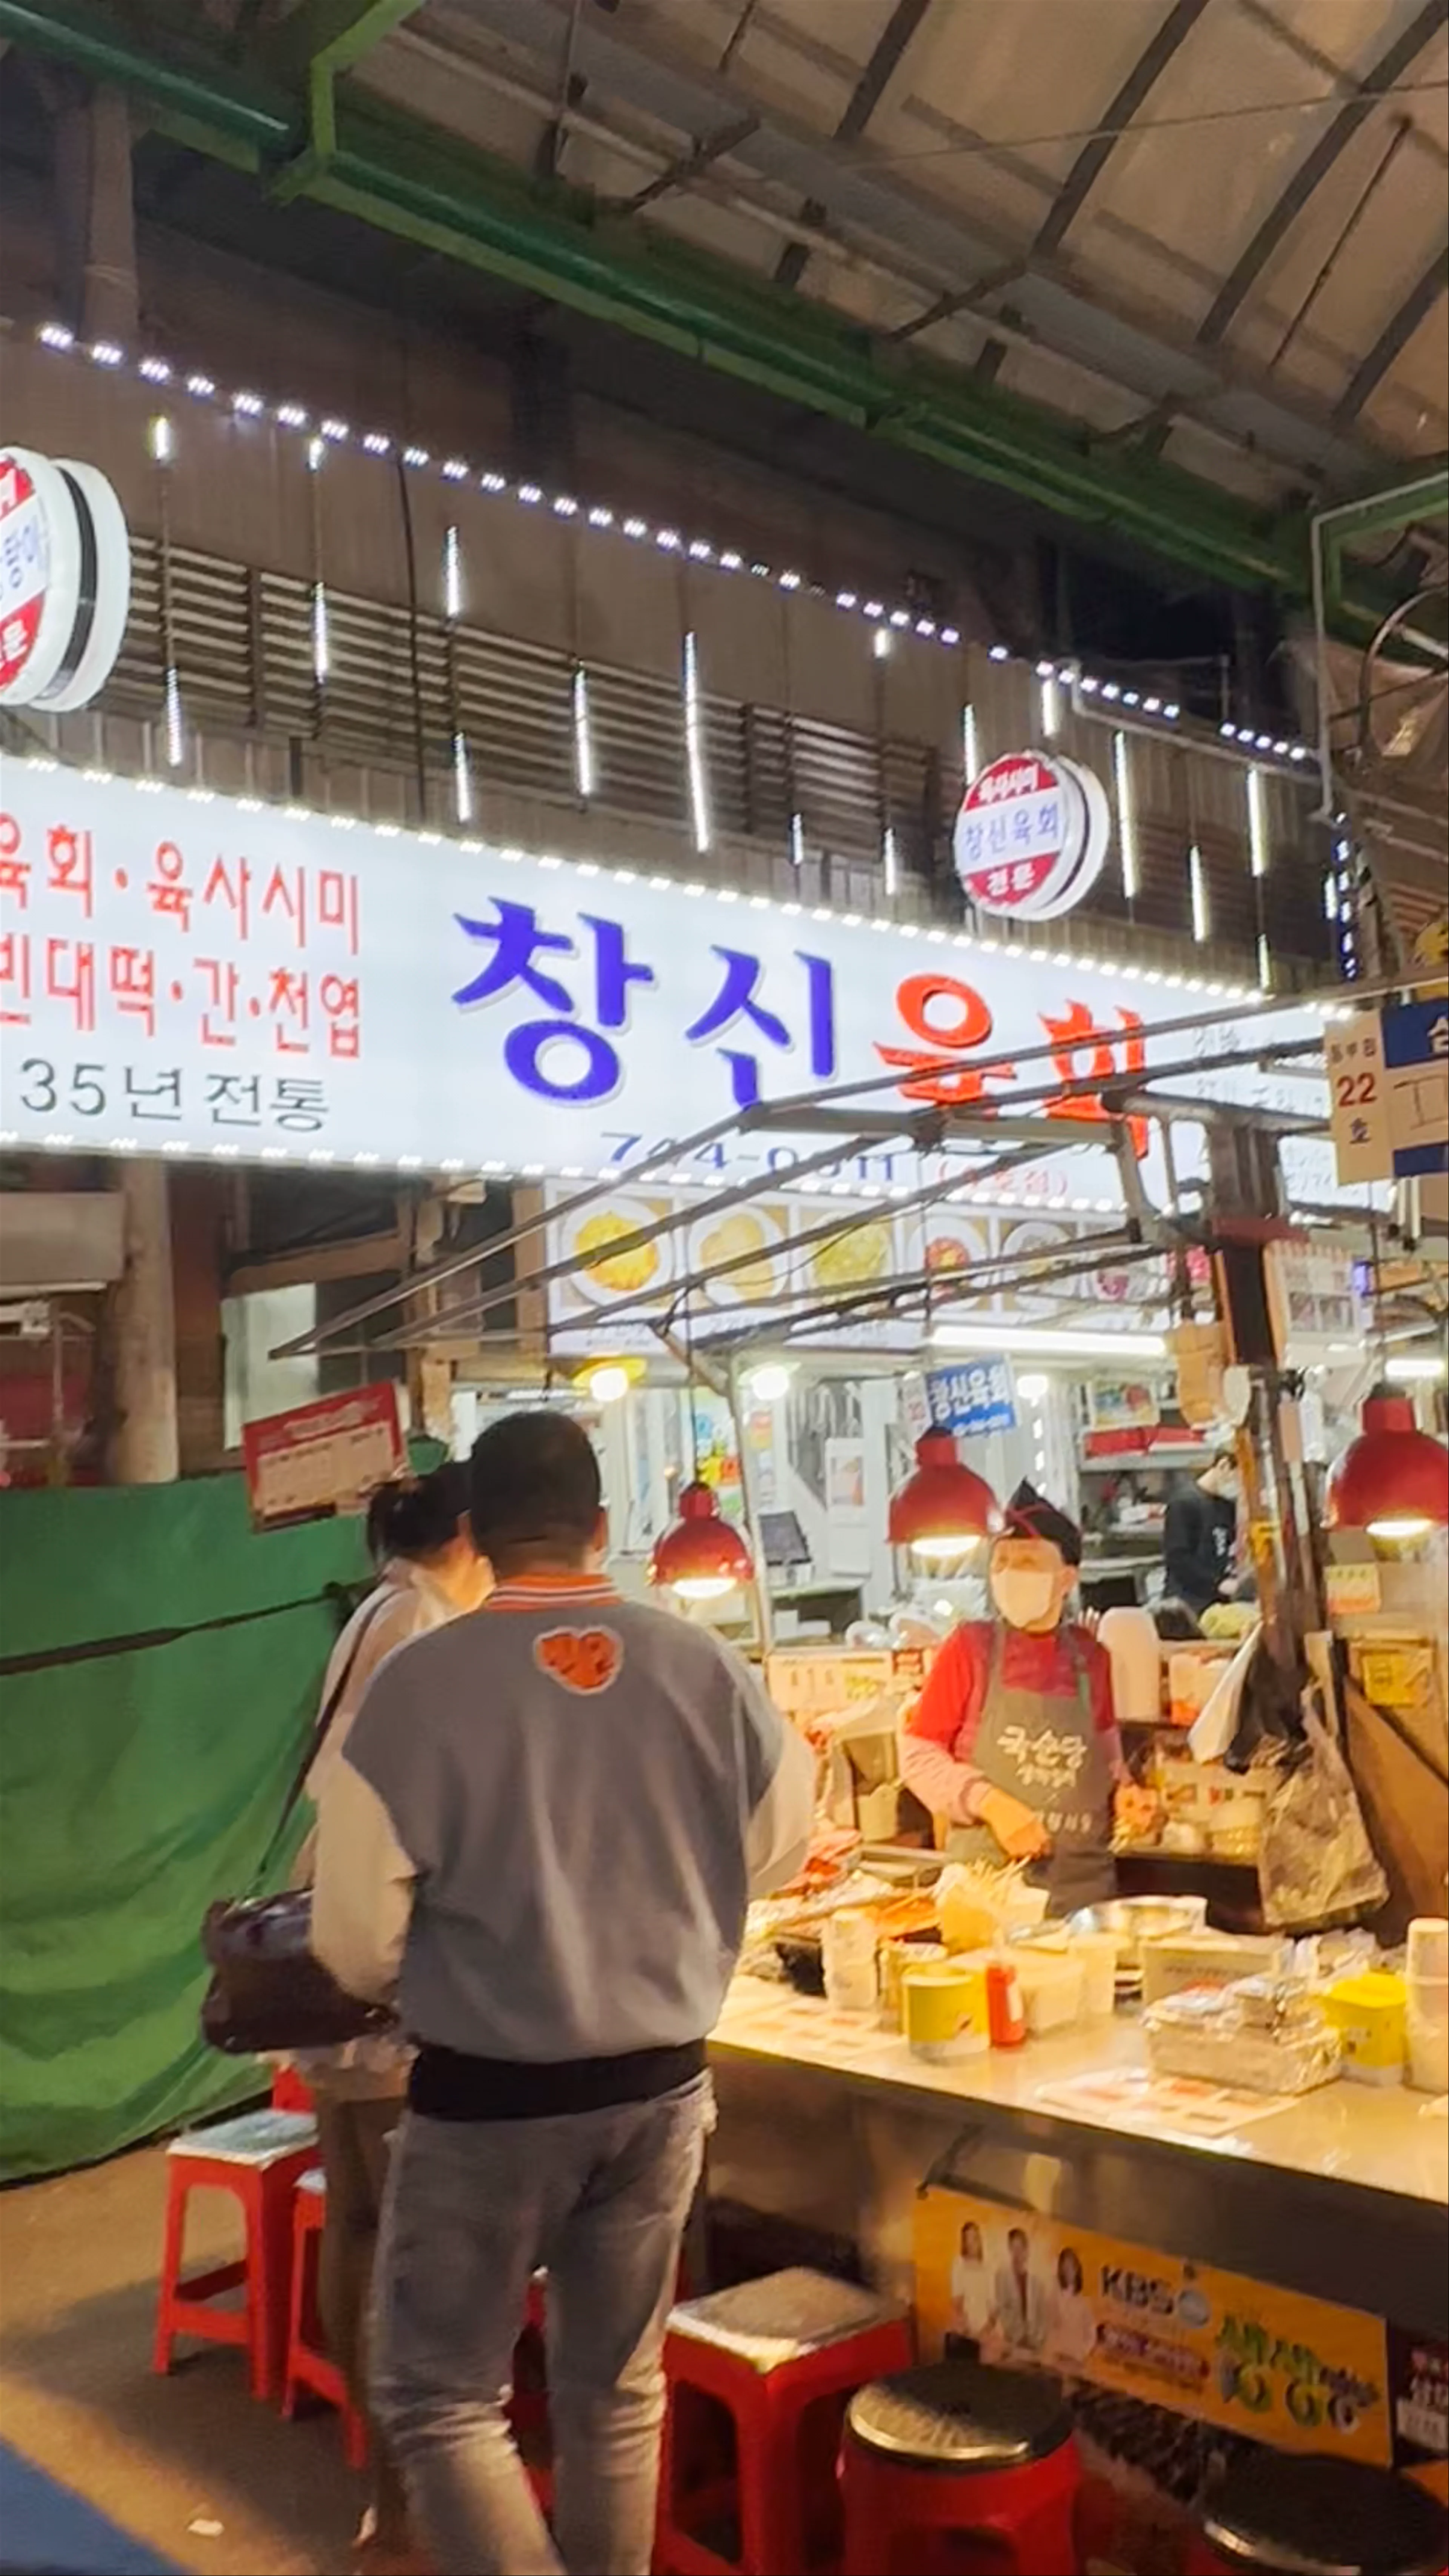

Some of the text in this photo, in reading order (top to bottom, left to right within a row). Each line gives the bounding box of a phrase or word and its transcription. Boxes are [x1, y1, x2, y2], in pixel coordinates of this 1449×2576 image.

[966, 803, 1059, 861] 창신육회
[20, 1058, 329, 1132] 35년 전통
[1337, 1072, 1378, 1108] 22
[996, 1724, 1088, 1770] 국순당
[1100, 2265, 1174, 2315] KBS
